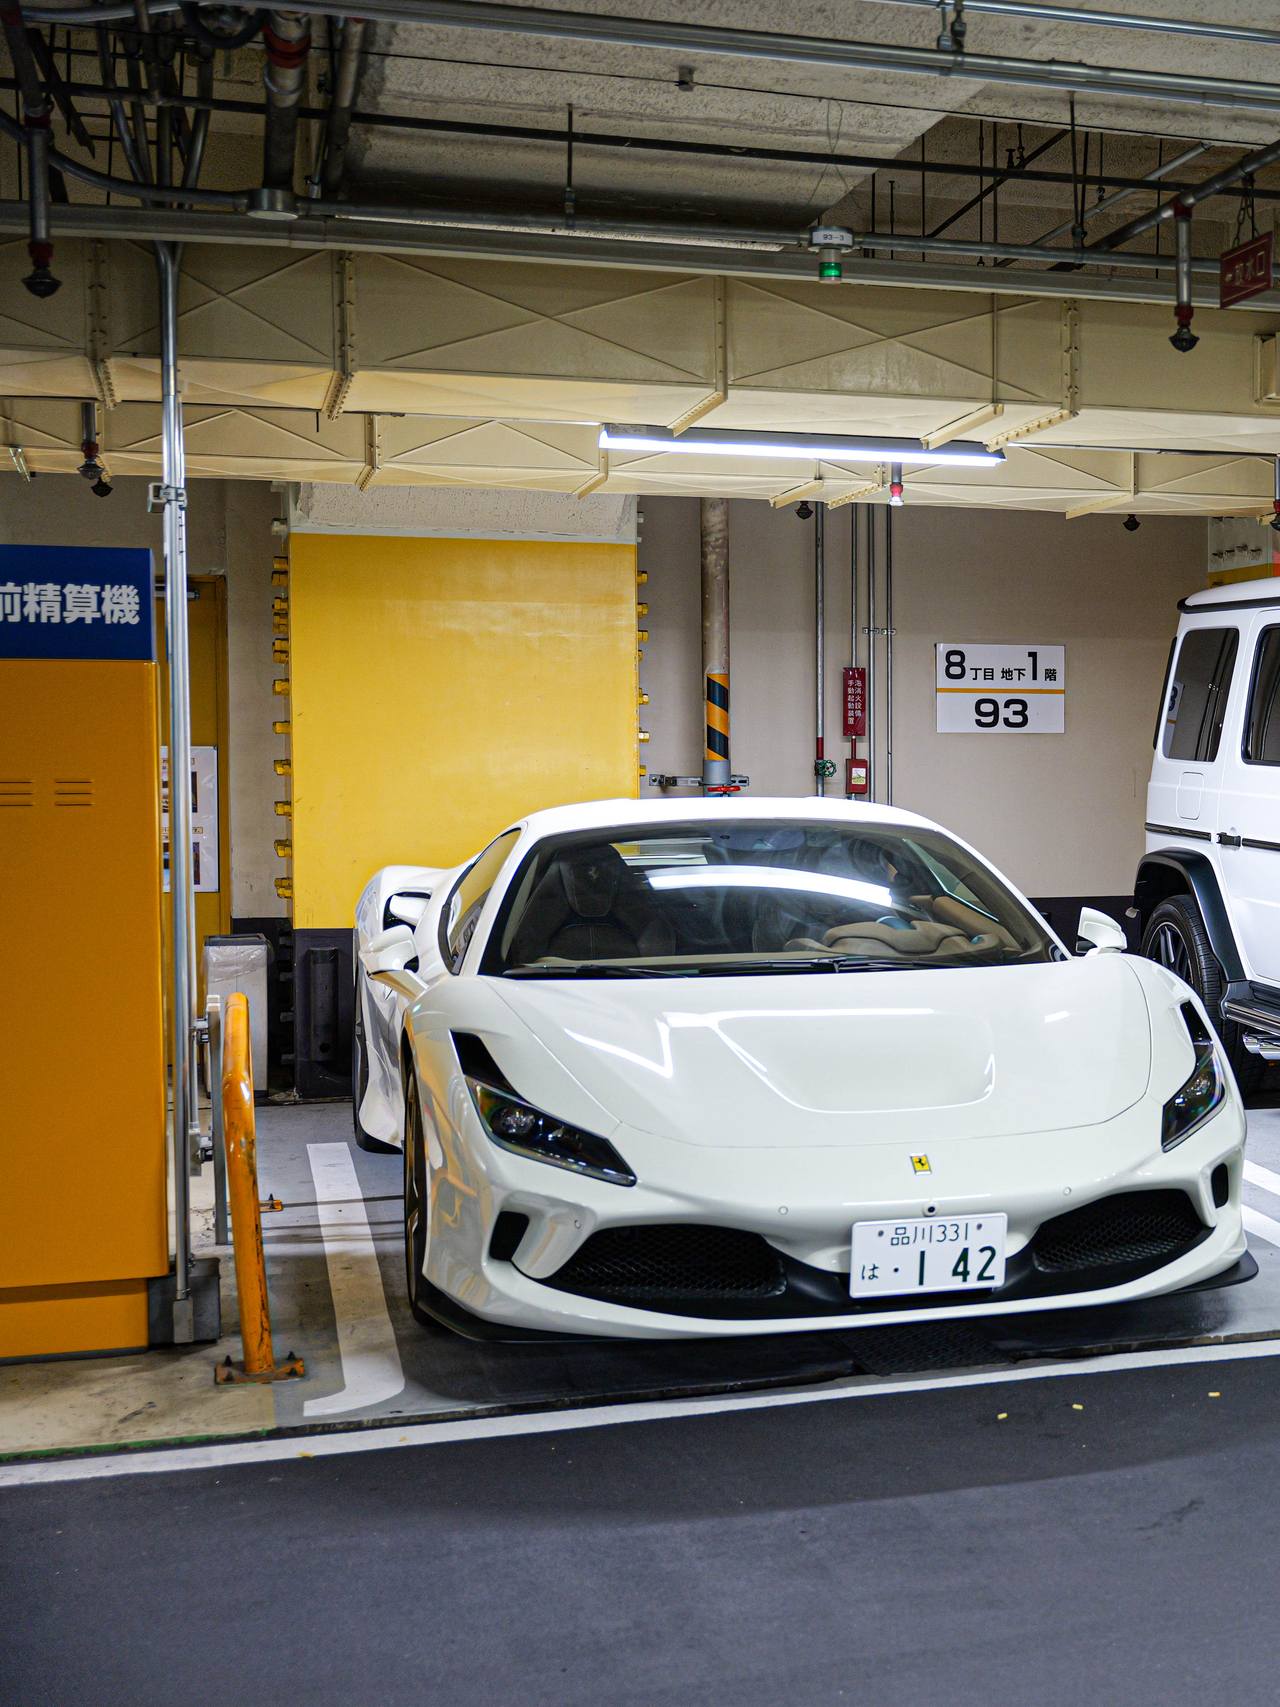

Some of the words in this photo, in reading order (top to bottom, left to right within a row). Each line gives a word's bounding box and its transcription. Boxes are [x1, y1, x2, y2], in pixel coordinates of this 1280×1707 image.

[0, 582, 140, 625] 前精算機
[974, 698, 1029, 728] 93
